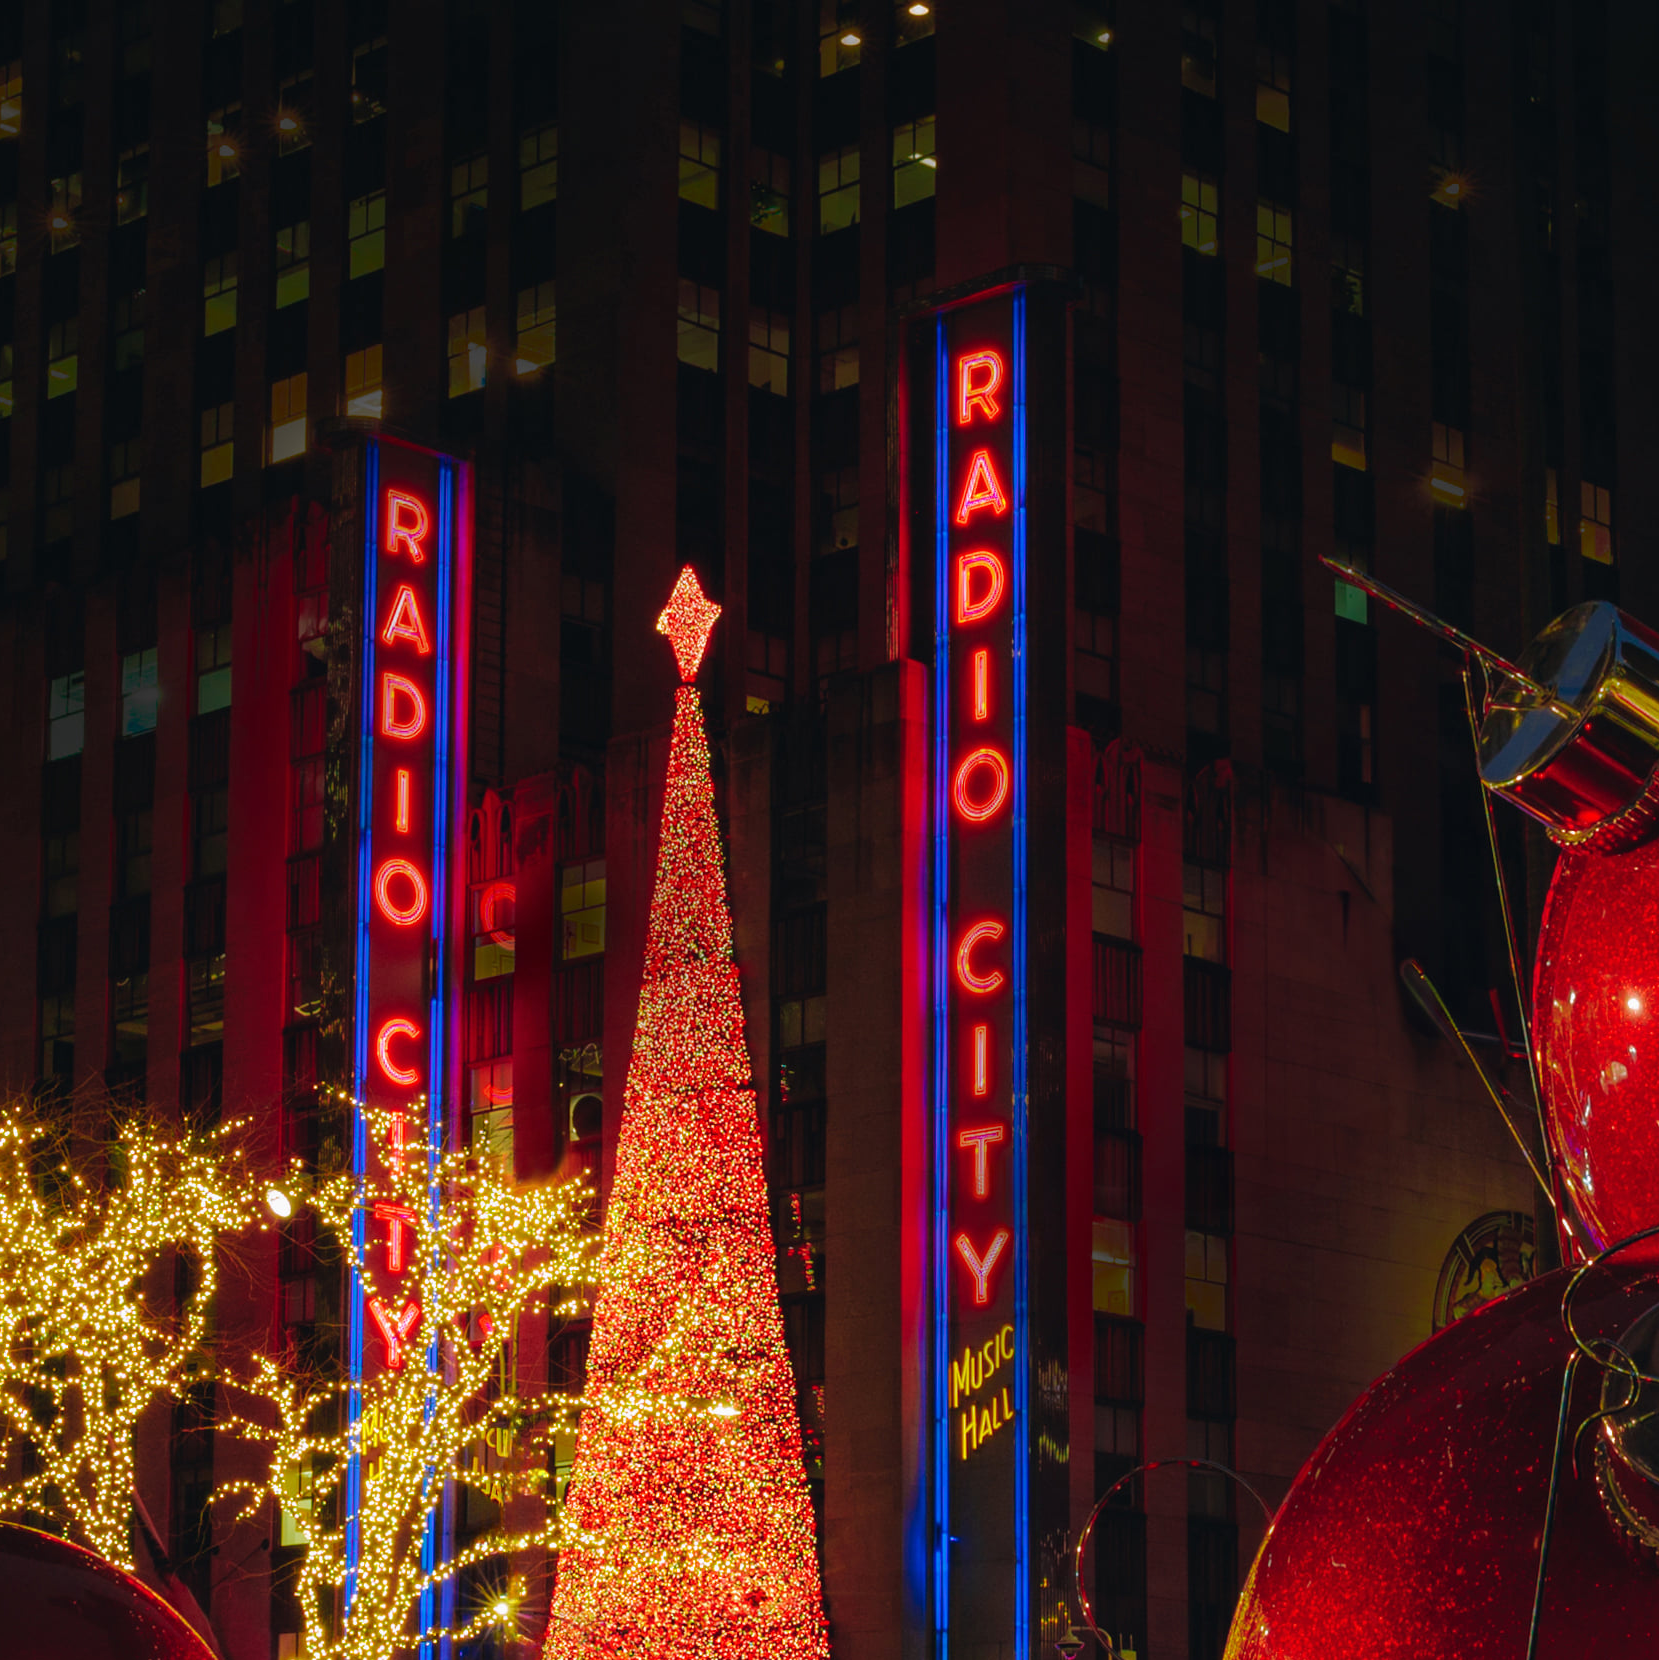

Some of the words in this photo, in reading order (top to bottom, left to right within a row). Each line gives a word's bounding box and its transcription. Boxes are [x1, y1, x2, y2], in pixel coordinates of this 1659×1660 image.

[374, 488, 430, 927] RADIO
[954, 349, 1008, 821] RADIO
[368, 1018, 421, 1368] CITY
[956, 920, 1008, 1303] CITY
[950, 1323, 1014, 1409] MUSIC
[961, 1389, 1014, 1461] HALL
